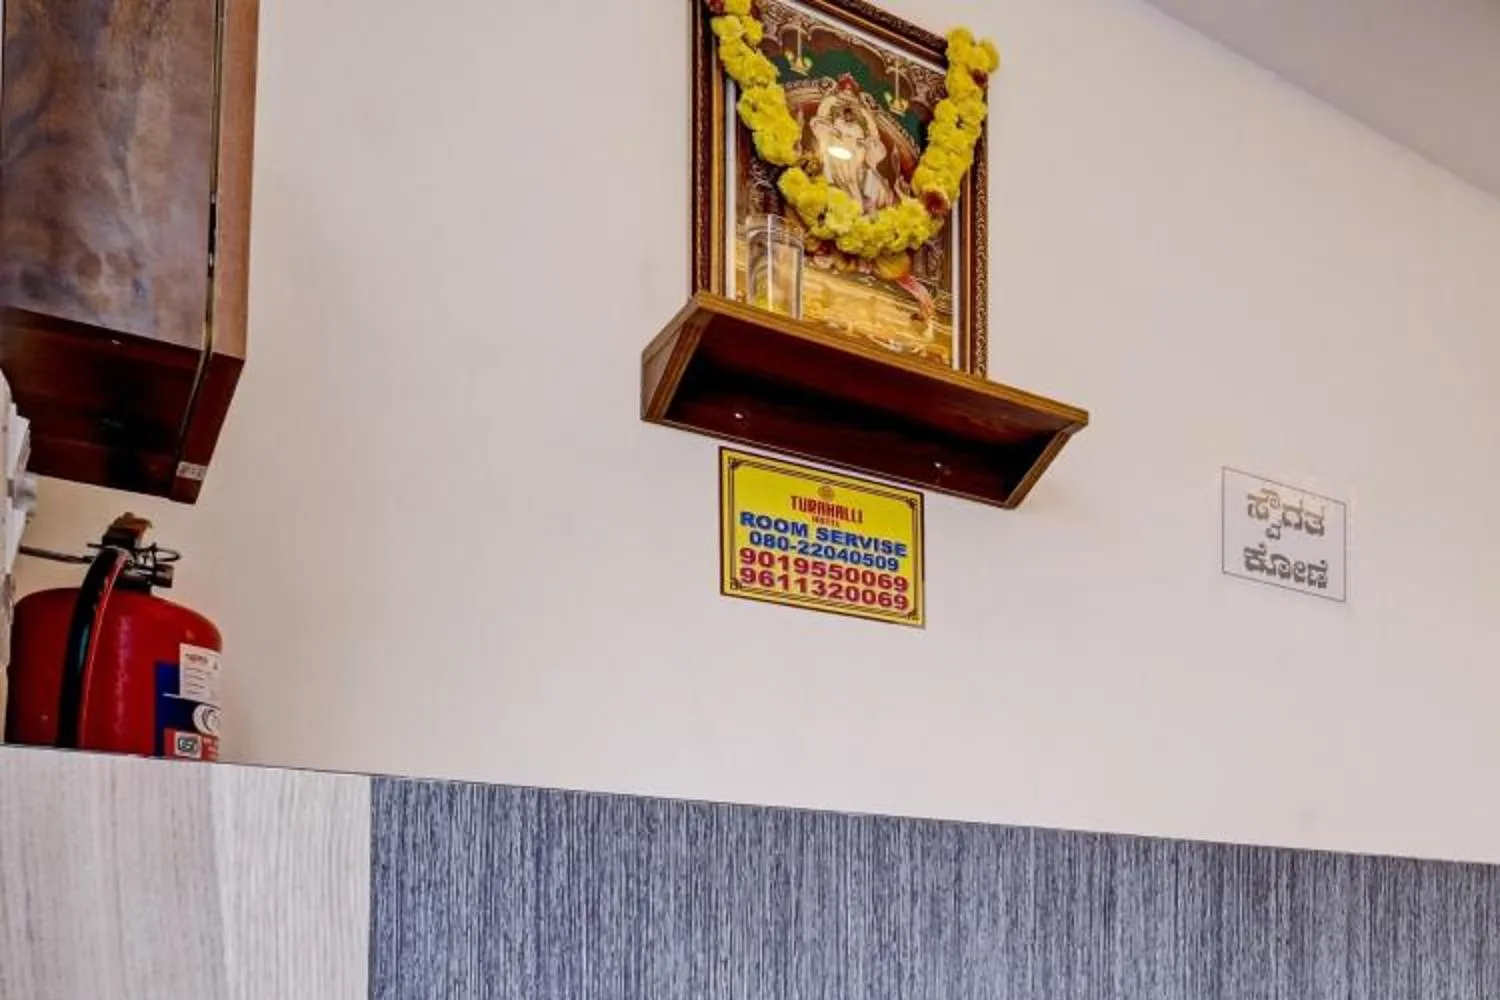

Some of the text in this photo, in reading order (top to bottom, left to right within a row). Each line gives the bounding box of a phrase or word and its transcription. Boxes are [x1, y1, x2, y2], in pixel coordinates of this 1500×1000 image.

[790, 495, 863, 525] TURAHALLI
[740, 511, 908, 557] ROOM SERVISE
[749, 531, 899, 571] 080-22040509
[739, 548, 909, 593] 9019550069
[739, 567, 909, 610] 9611320069
